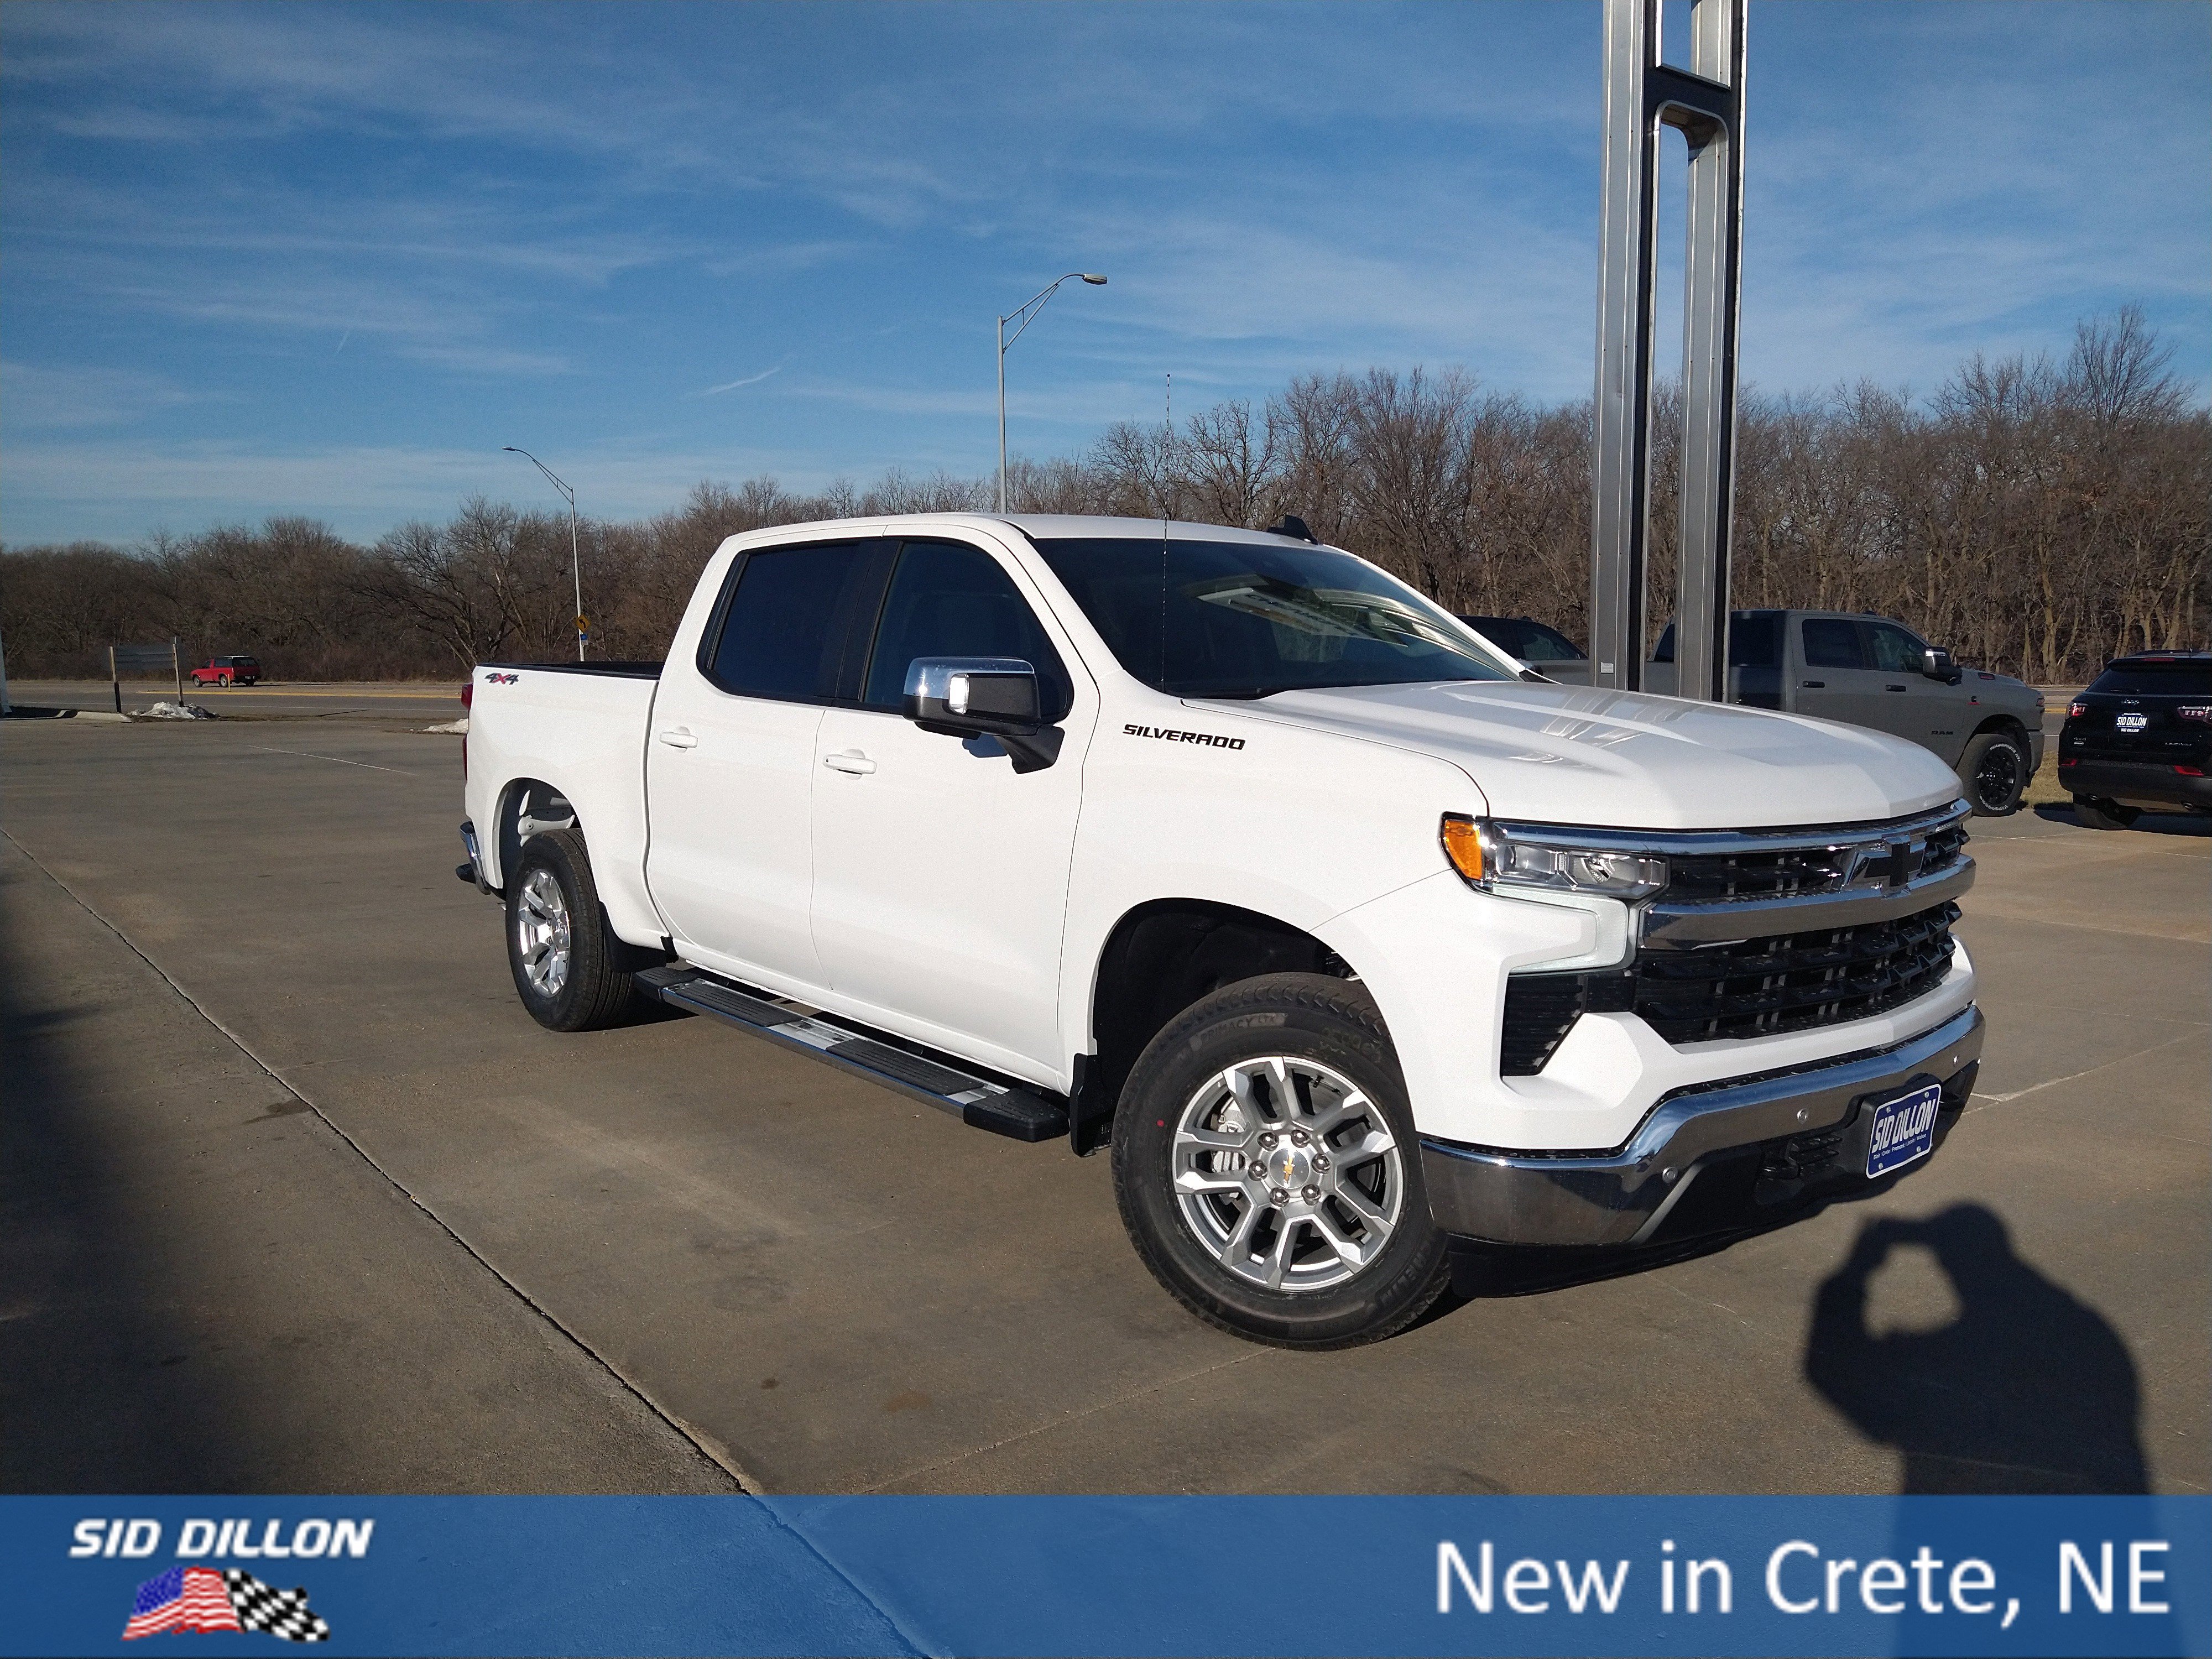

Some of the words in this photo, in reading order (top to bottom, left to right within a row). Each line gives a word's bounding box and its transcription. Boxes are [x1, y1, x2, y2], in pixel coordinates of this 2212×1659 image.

[2116, 717, 2127, 726] SID
[2126, 717, 2147, 726] DILLON
[1123, 724, 1245, 750] SILVERADO
[1200, 1018, 1254, 1041] PRIMACY
[1871, 1115, 1895, 1154] SID
[1891, 1099, 1937, 1145] DILLON
